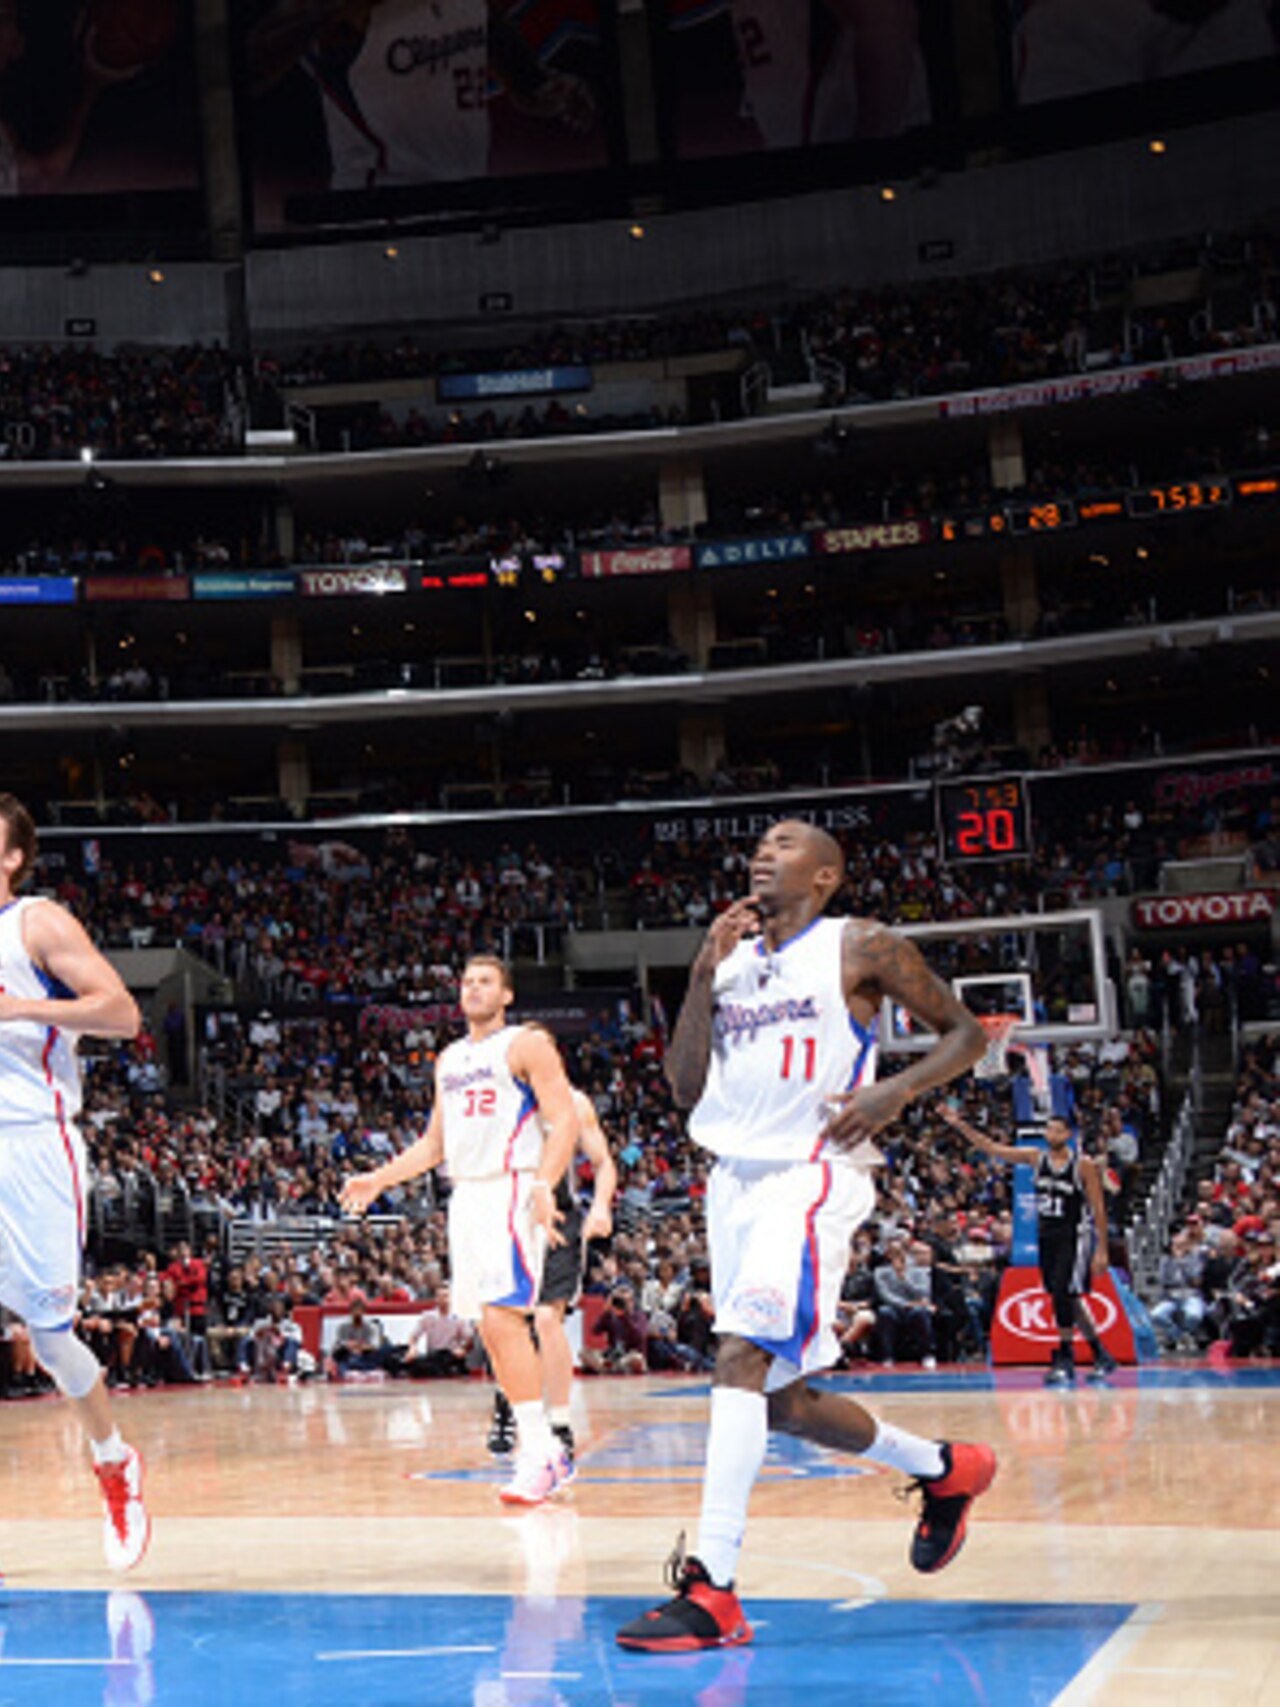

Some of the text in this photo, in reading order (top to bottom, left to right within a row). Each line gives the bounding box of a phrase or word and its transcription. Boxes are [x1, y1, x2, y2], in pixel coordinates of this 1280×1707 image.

[723, 538, 807, 563] DELTA
[959, 810, 1015, 855] 20
[1137, 892, 1273, 926] TOYOTA
[780, 1034, 816, 1082] 11
